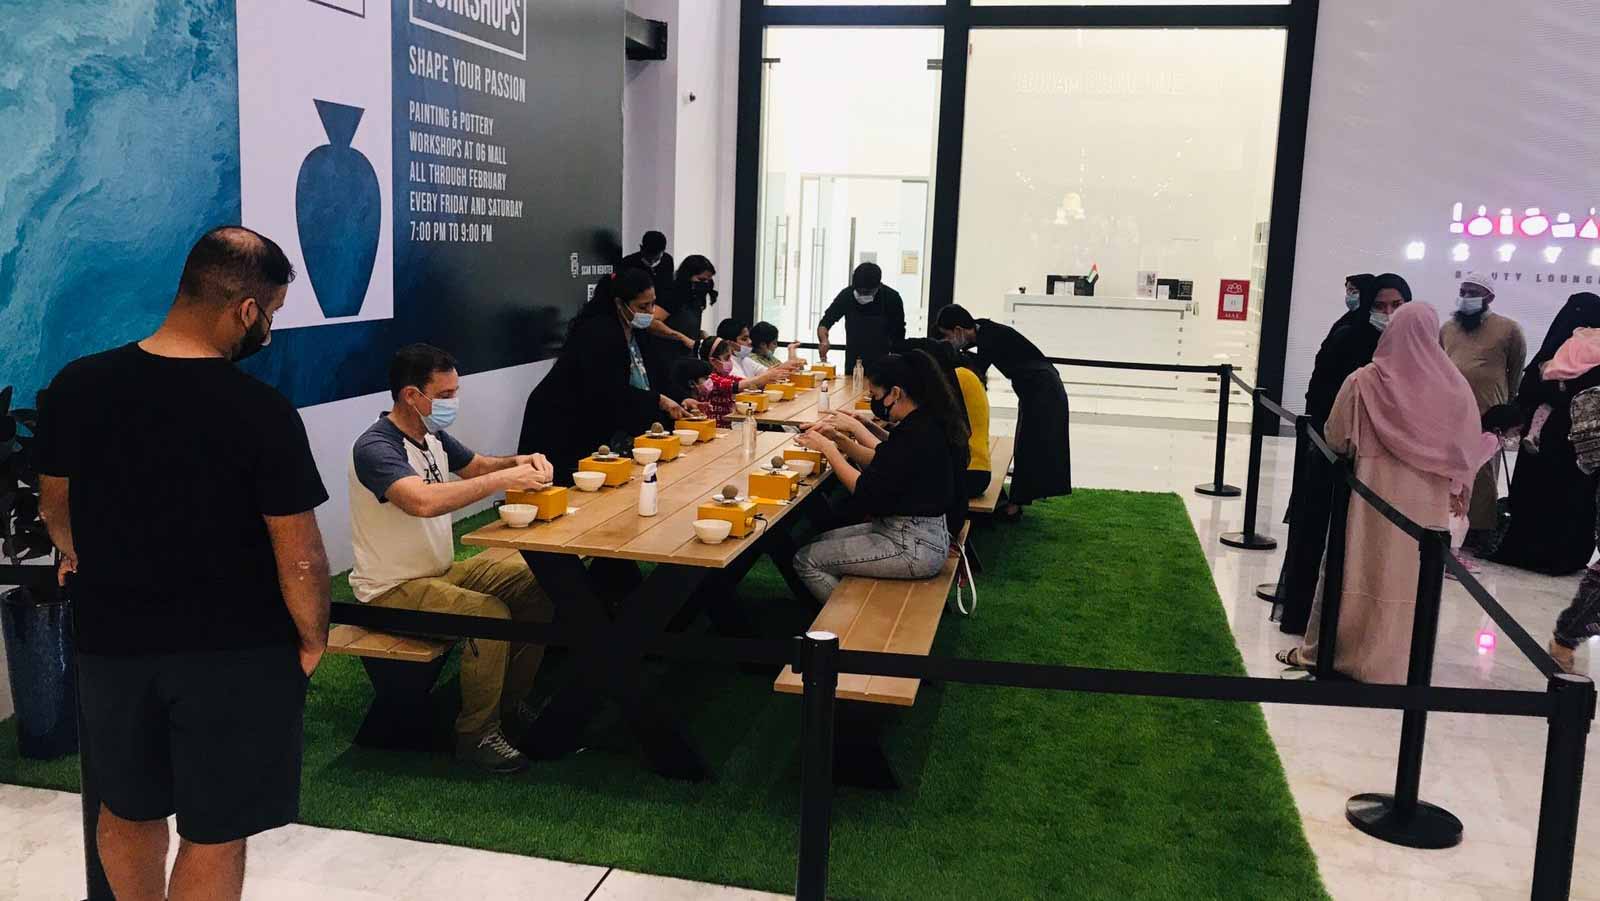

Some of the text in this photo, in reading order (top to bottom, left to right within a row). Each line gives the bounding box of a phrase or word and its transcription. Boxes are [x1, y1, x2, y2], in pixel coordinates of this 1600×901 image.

[409, 45, 526, 103] SHAPE YOUR PASSION
[409, 100, 495, 136] PAINTING & POTTERY
[409, 130, 462, 159] WORKSHOPS
[464, 141, 474, 160] AT
[487, 144, 507, 165] MALL
[409, 161, 507, 191] ALL THROUGH FEBRUARY
[410, 191, 523, 218] EVERY FRIDAY AND SATURDAY
[410, 220, 493, 242] 7:00 PM TO 9:00 PM
[1455, 270, 1522, 281] BUTY
